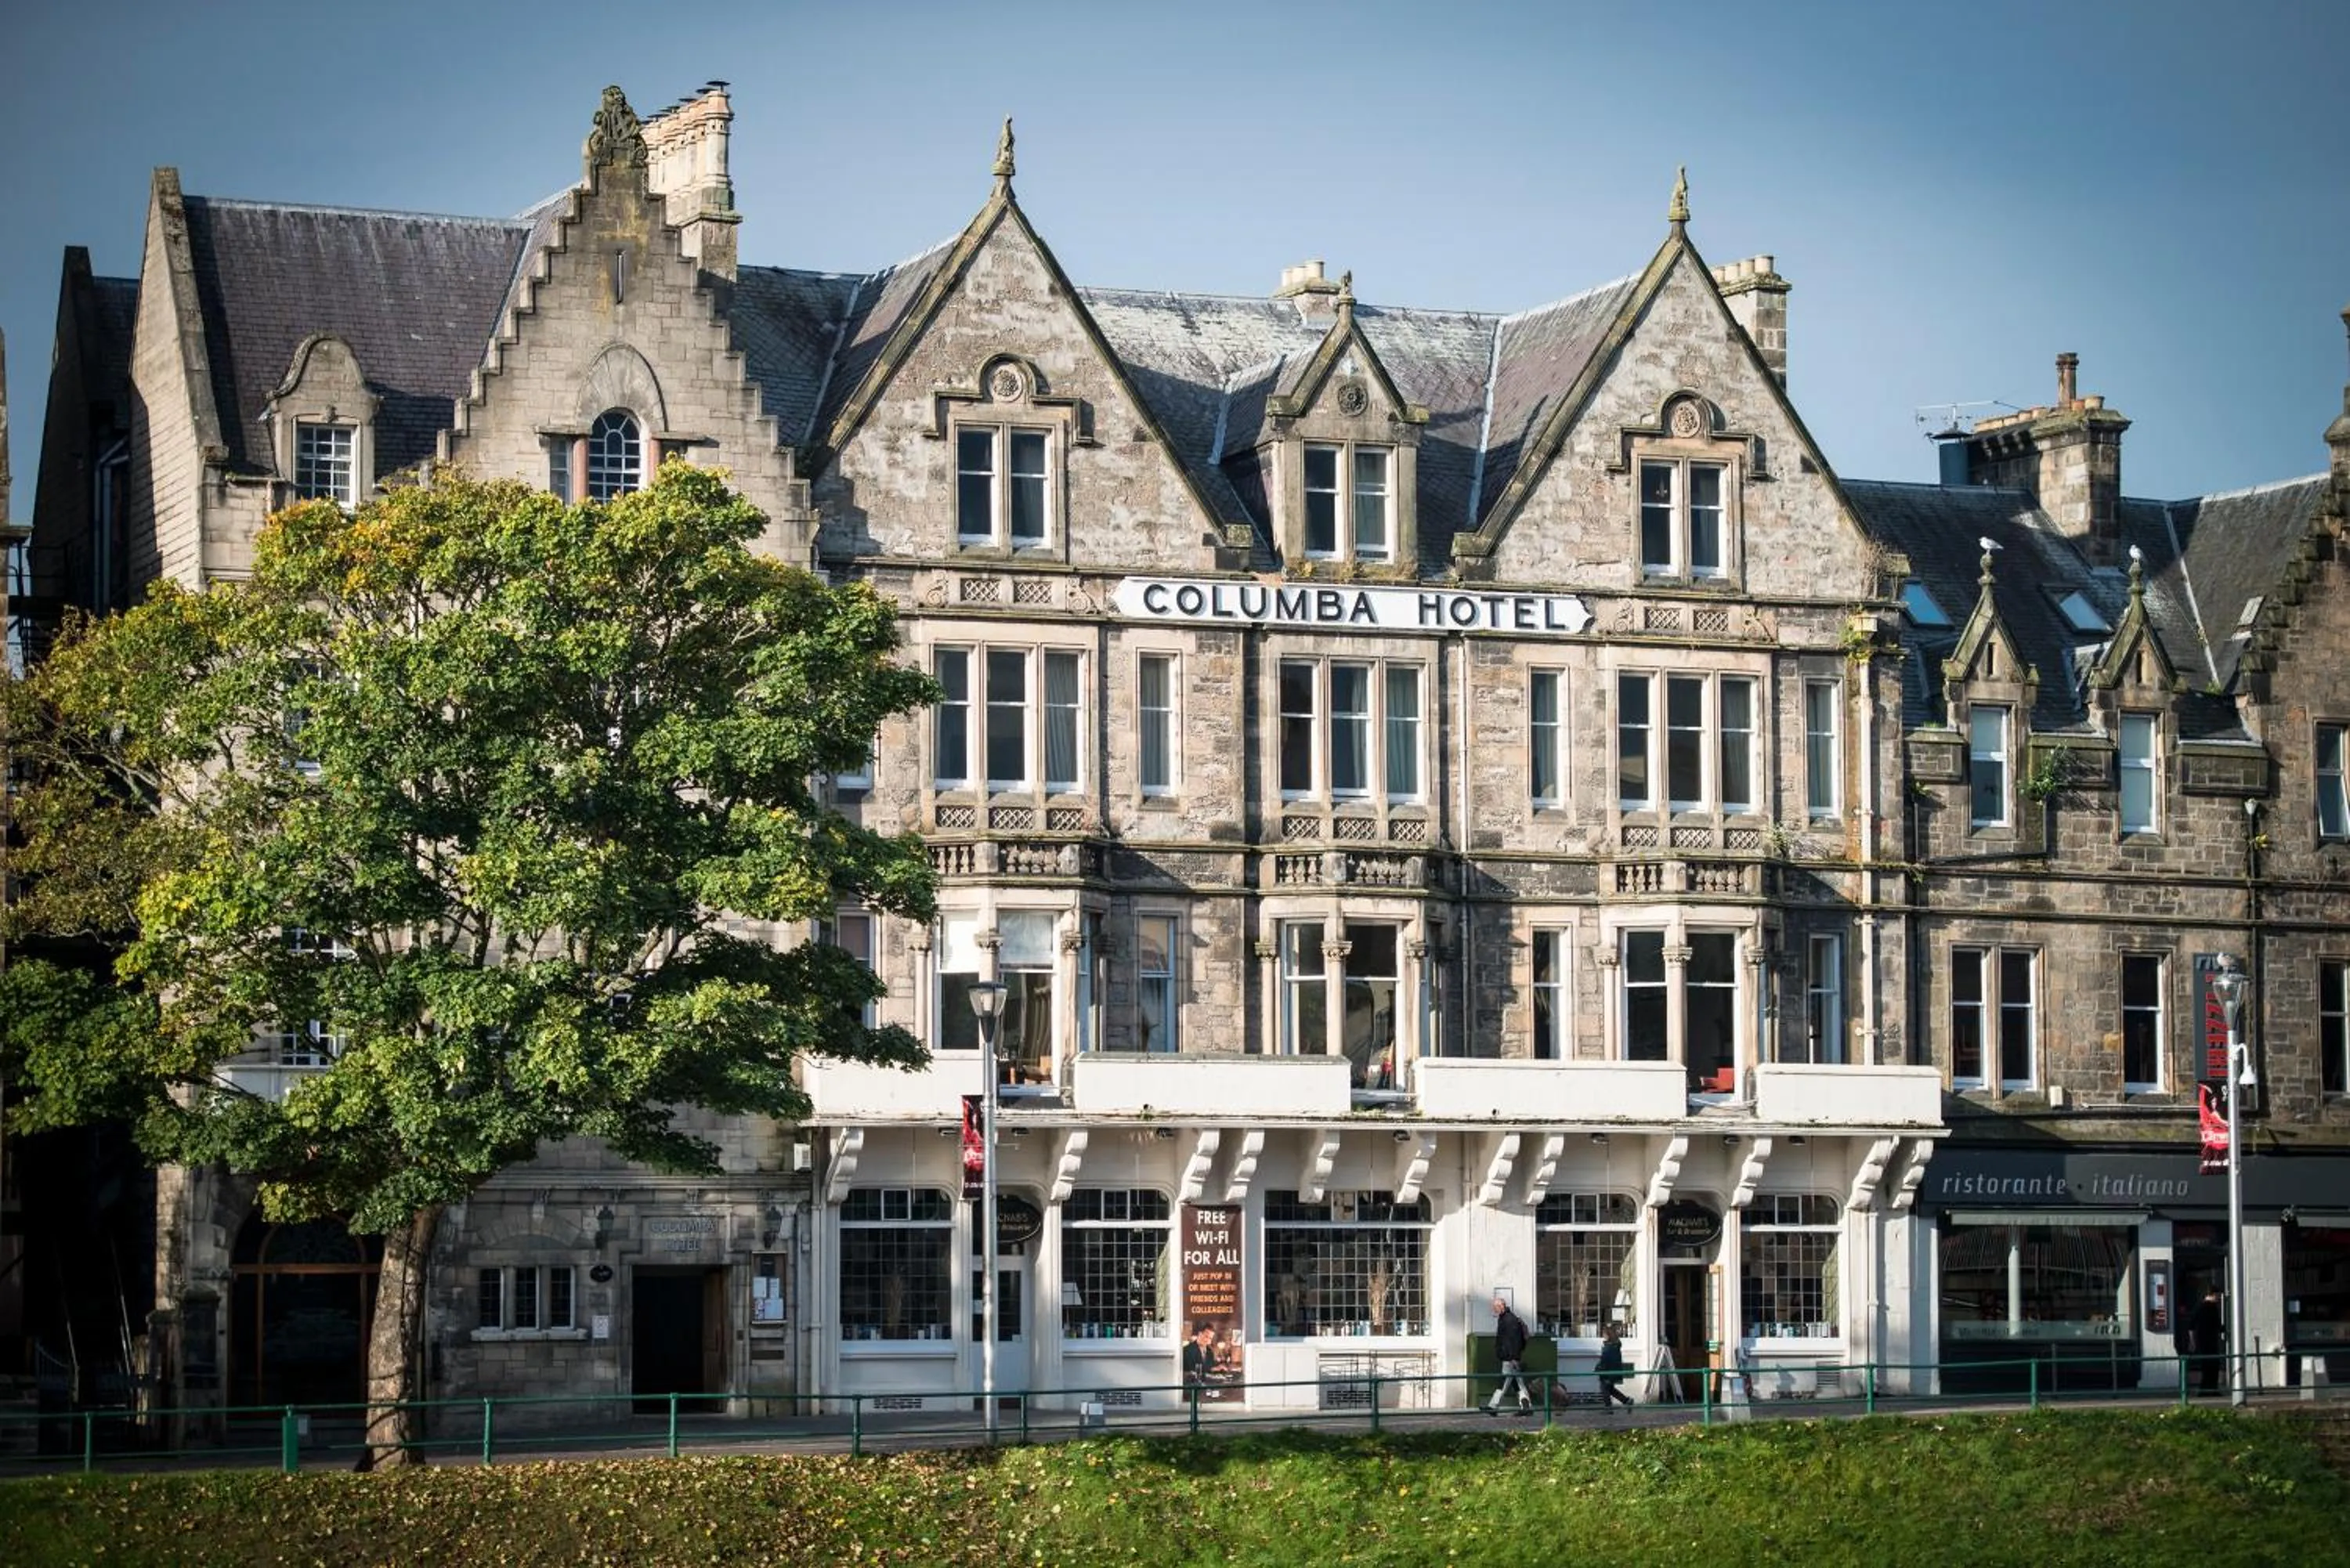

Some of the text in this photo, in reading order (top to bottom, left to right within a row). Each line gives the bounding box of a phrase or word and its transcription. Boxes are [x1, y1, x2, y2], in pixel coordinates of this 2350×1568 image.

[1143, 583, 1569, 630] COLUMBA HOTEL
[1942, 1172, 2188, 1196] ristorante italiano
[1197, 1210, 1226, 1224] FREE
[1195, 1230, 1228, 1245] WI-FI
[1184, 1248, 1240, 1265] FOR ALL
[1193, 1272, 1208, 1281] JUST
